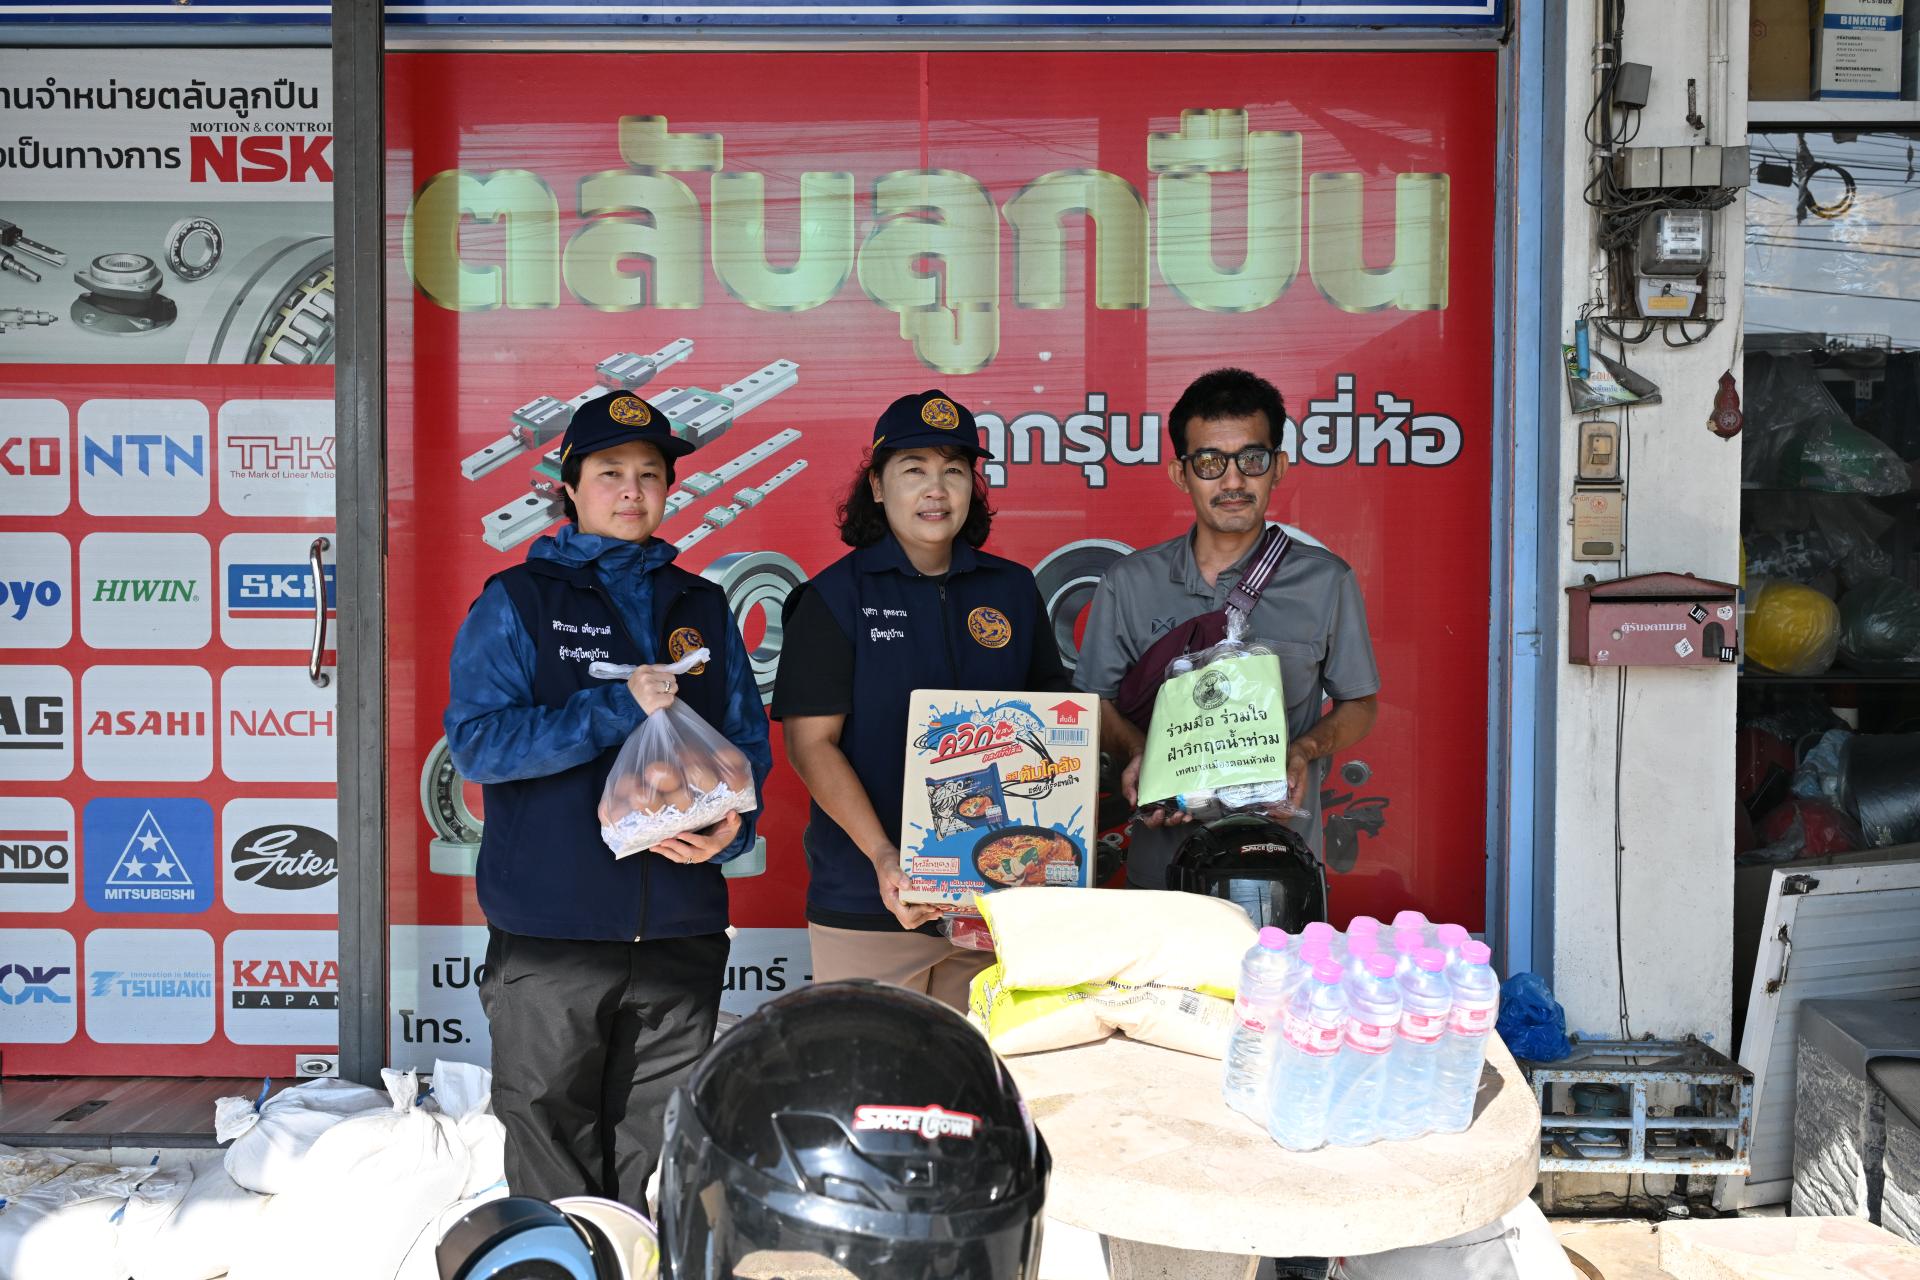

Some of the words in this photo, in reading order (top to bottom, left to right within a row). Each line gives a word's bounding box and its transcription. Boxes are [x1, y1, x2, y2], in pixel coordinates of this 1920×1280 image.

[1840, 15, 1887, 27] BINKING
[190, 122, 251, 133] MOTION
[253, 123, 262, 132] &
[190, 136, 334, 183] NSK
[402, 107, 1451, 375] ตลับลูกปืน
[84, 434, 204, 477] NTN
[228, 436, 336, 470] THK
[230, 471, 246, 479] The
[248, 471, 269, 479] Mark
[271, 471, 280, 479] of
[282, 471, 308, 479] Linear
[92, 579, 197, 602] HIWIN
[87, 710, 205, 737] ASAHI
[1166, 714, 1215, 738] ร่วมมือ
[1220, 703, 1269, 725] ร่วมใจ
[1167, 729, 1280, 763] ฝ่าวิกฤตน้ำท่วม
[232, 829, 339, 882] Gates
[105, 888, 195, 900] MITSUBOSHI
[233, 960, 338, 987] KANA
[116, 980, 211, 998] TSUBAKI
[398, 1009, 471, 1044] โทร.
